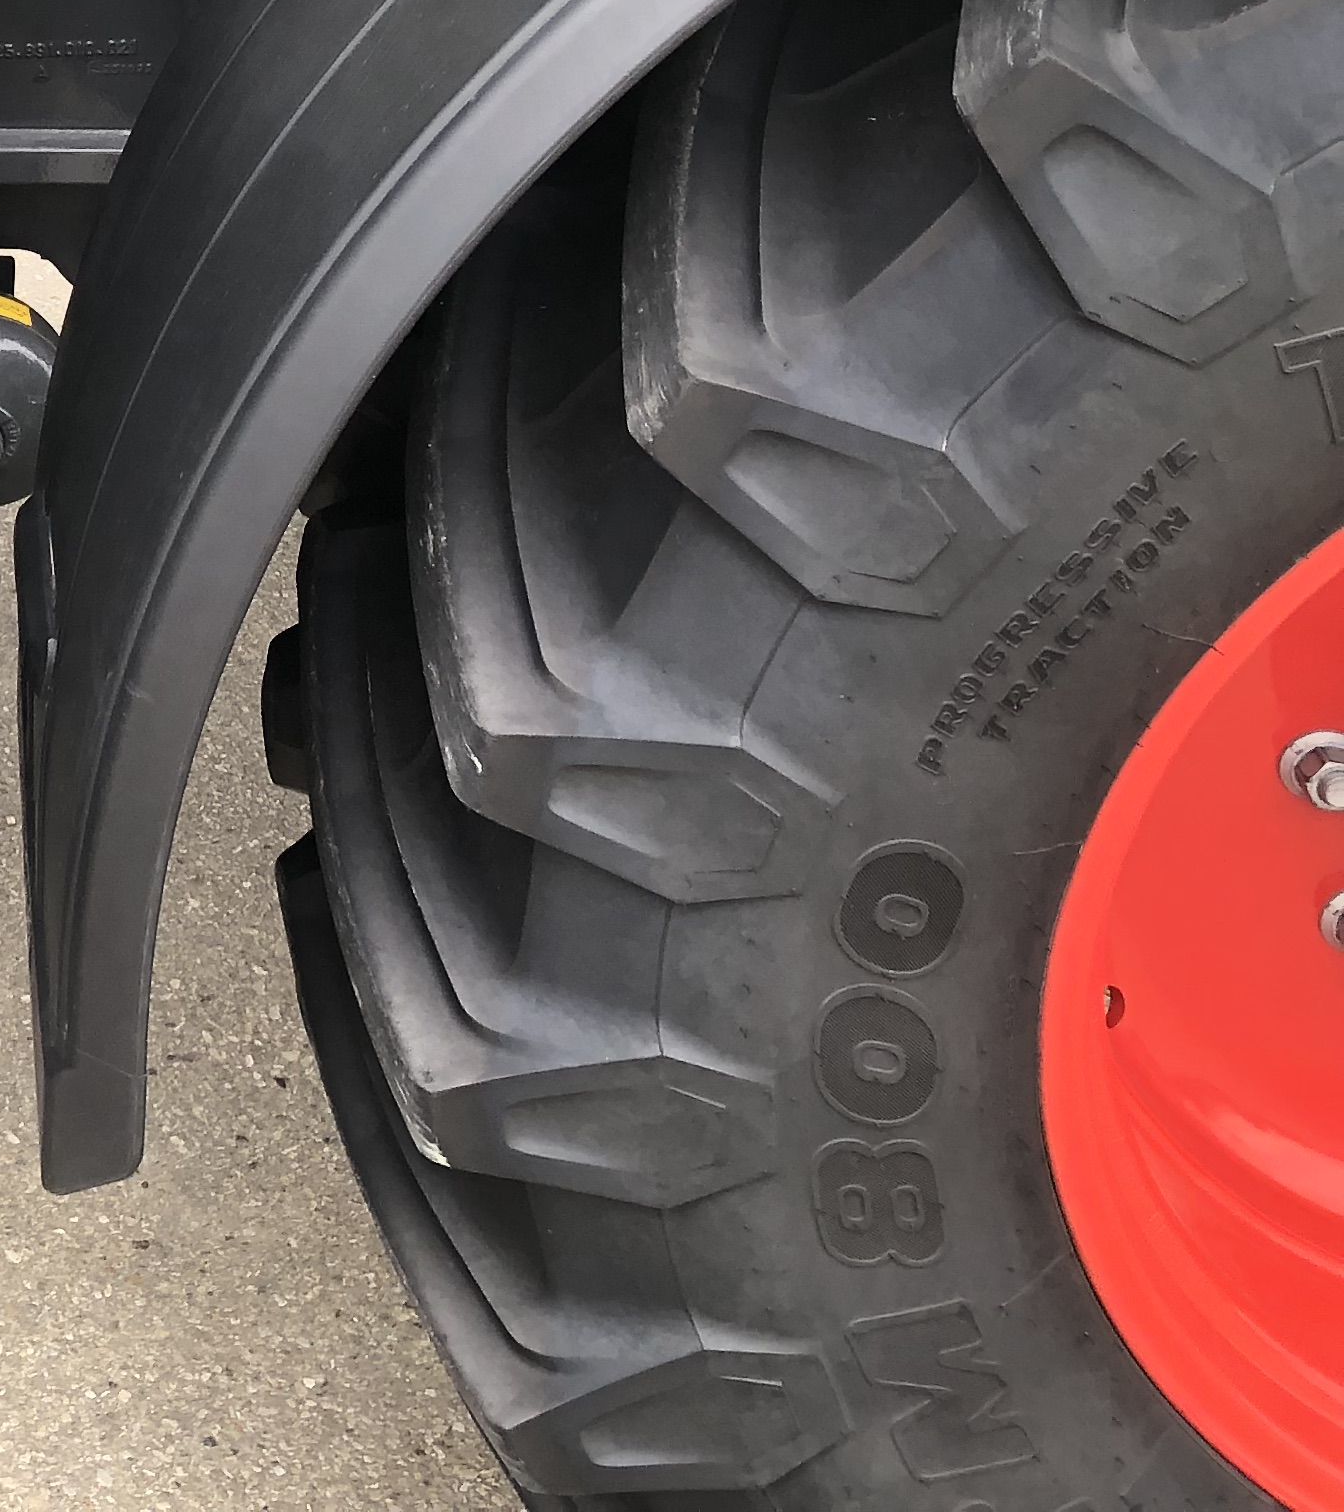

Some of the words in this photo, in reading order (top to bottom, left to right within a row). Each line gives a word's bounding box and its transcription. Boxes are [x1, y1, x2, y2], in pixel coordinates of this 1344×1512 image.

[915, 438, 1199, 776] PROGRESSIVE
[978, 505, 1192, 742] TRACTION
[811, 837, 1040, 1488] M800
